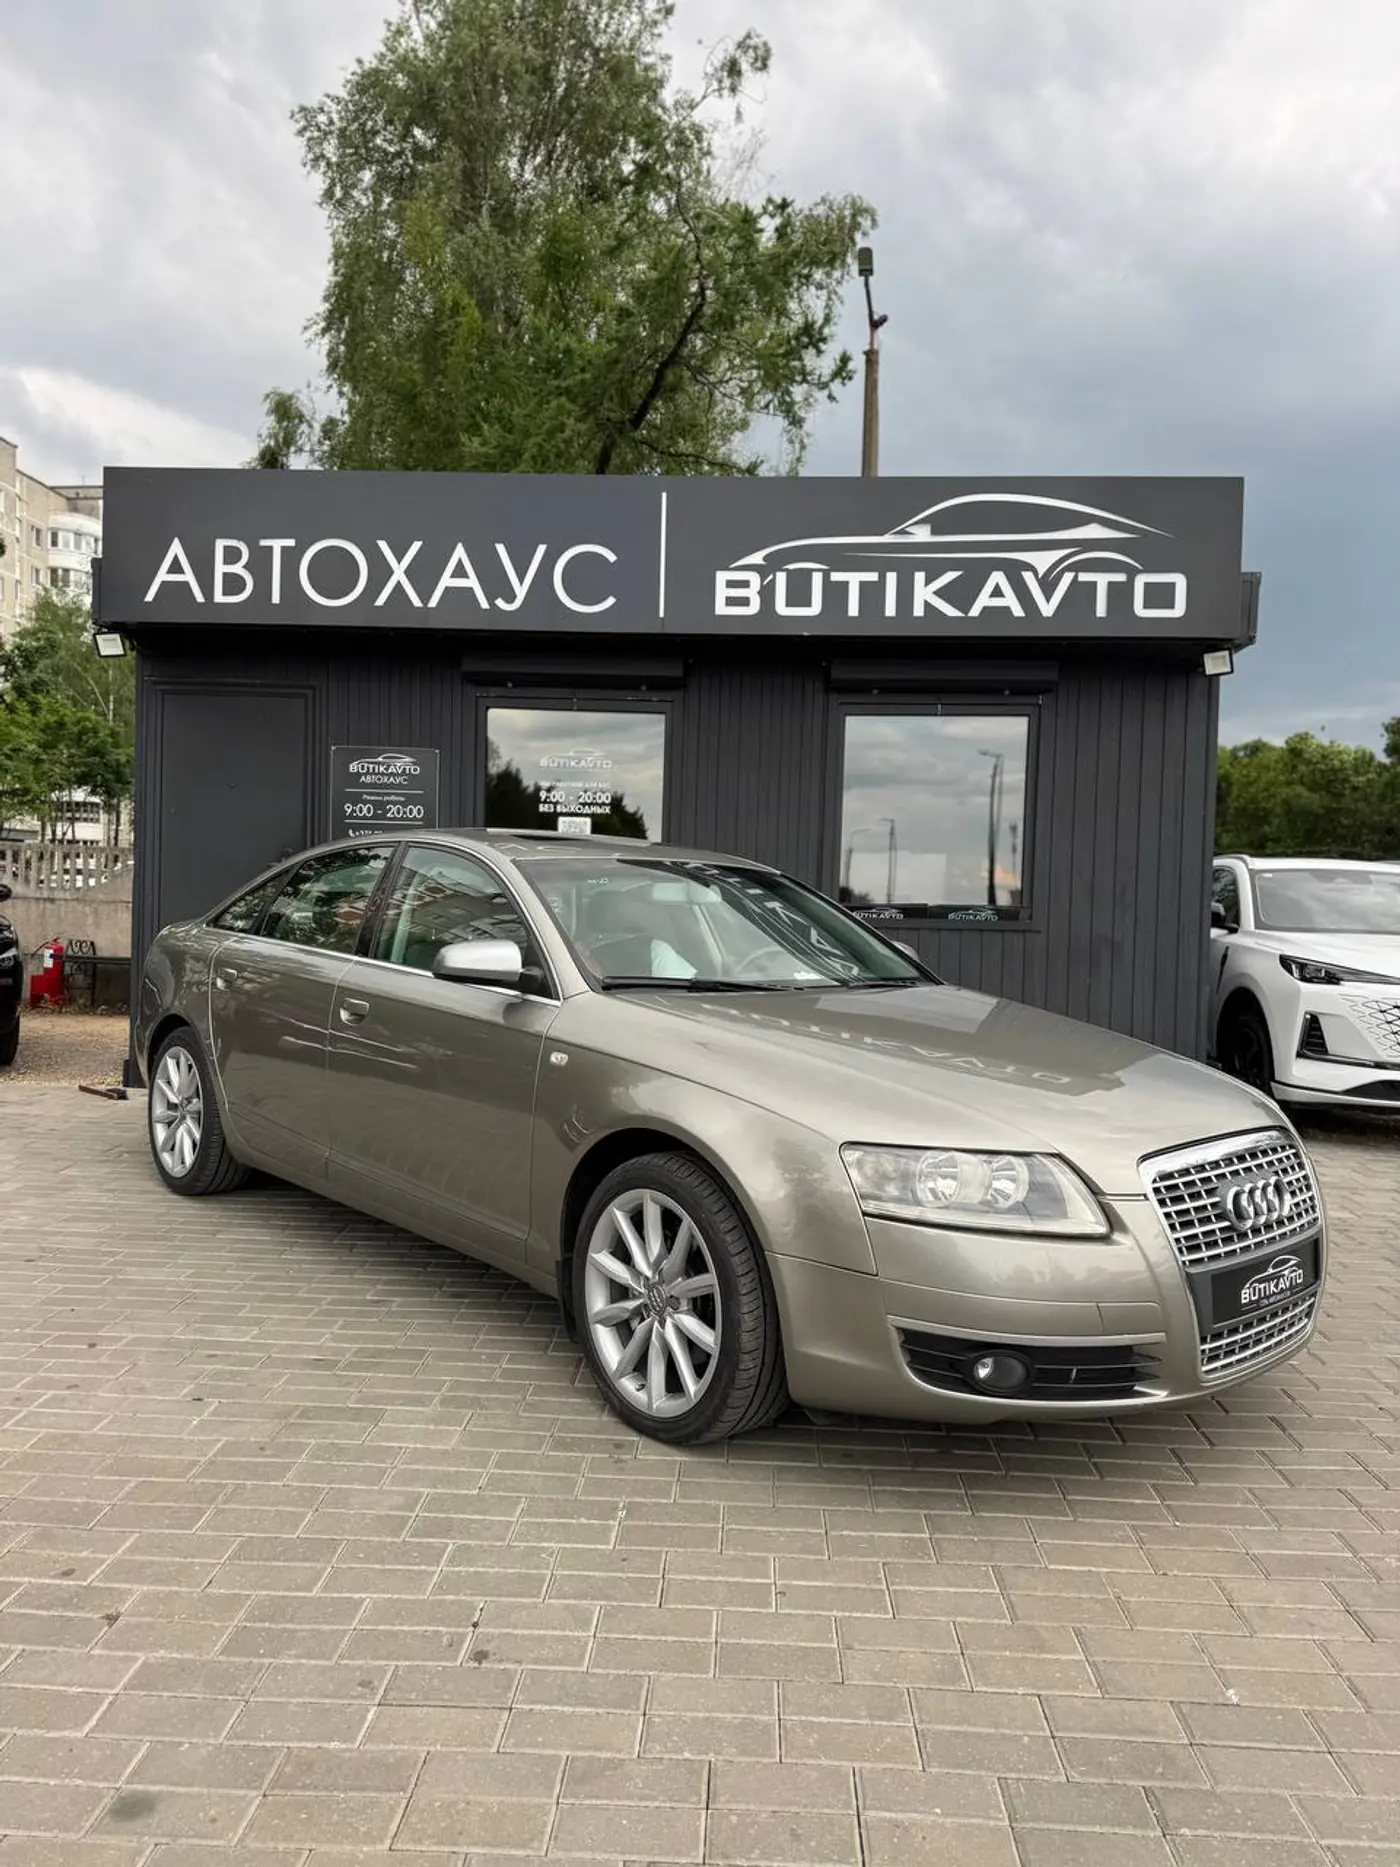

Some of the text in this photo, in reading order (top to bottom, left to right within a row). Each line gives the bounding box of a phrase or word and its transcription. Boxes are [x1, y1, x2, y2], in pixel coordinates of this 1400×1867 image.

[144, 537, 618, 614] АВТОХАУС
[714, 569, 1188, 619] BUTIKAVTO
[349, 763, 420, 774] BUTIKAVTO
[359, 775, 408, 784] АВТОХАУС
[540, 790, 566, 802] 9:00
[577, 791, 612, 804] 20:00
[344, 803, 374, 817] 9:00
[386, 804, 424, 818] 20:00
[555, 804, 611, 814] ВЫХОДНЫХ
[1241, 1269, 1304, 1304] BUTIKAVTO
